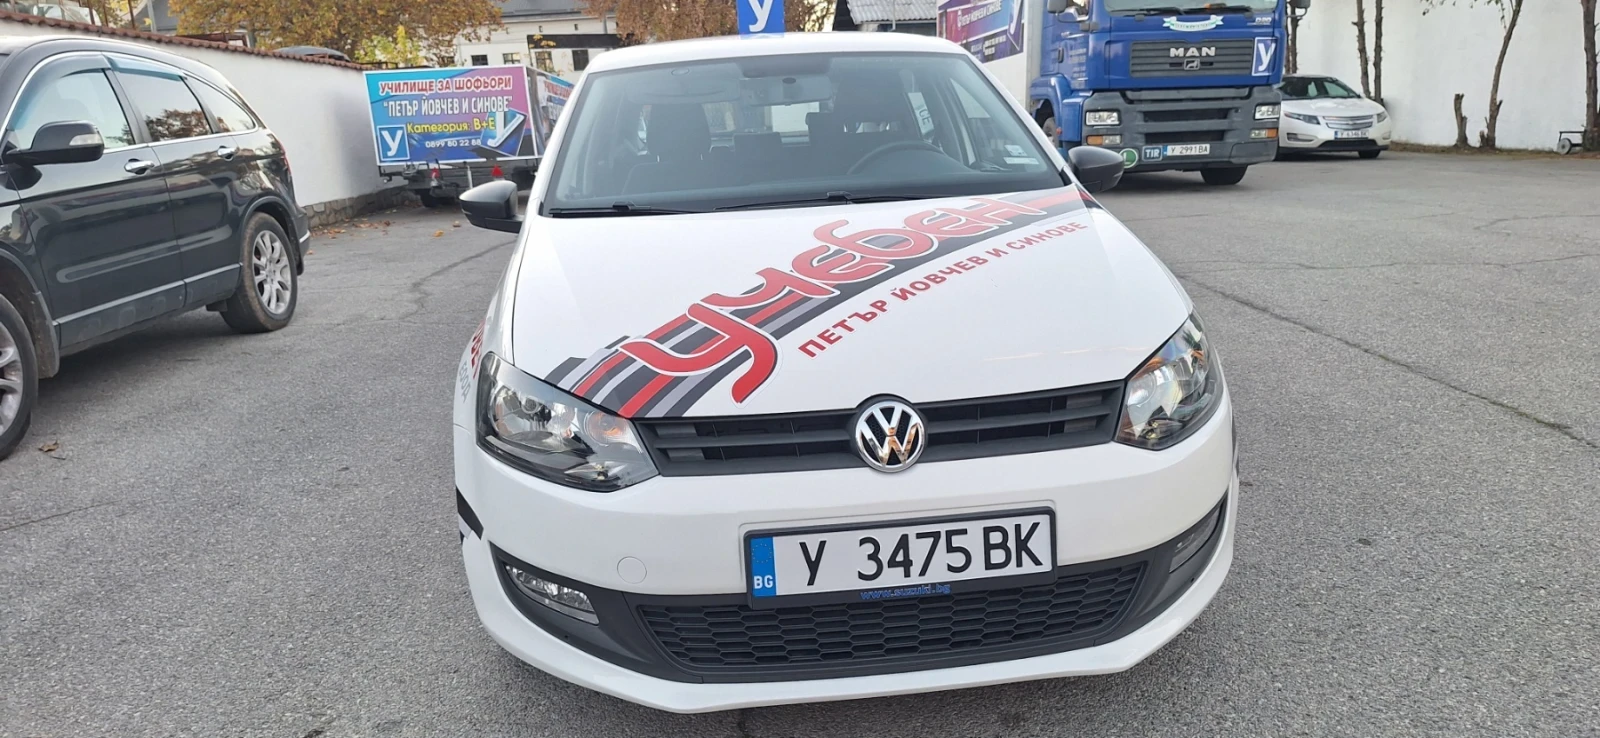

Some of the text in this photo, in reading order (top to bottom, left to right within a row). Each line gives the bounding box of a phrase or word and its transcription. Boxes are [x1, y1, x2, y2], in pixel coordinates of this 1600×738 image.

[1169, 46, 1216, 57] MAN
[380, 77, 512, 95] УЧИЛИЩЕ ЗА ШОФЬОРИ
[421, 96, 459, 116] ЙОВЧЕВ
[462, 99, 469, 113] И
[407, 122, 471, 134] Категория:
[1145, 149, 1160, 158] TIR
[798, 221, 1088, 358] ПЕТЪР ЙОВЧЕВ И СИНОВЕ
[857, 528, 972, 582] 3475
[753, 575, 774, 589] BG
[860, 583, 951, 600] www.suzuki.bg
